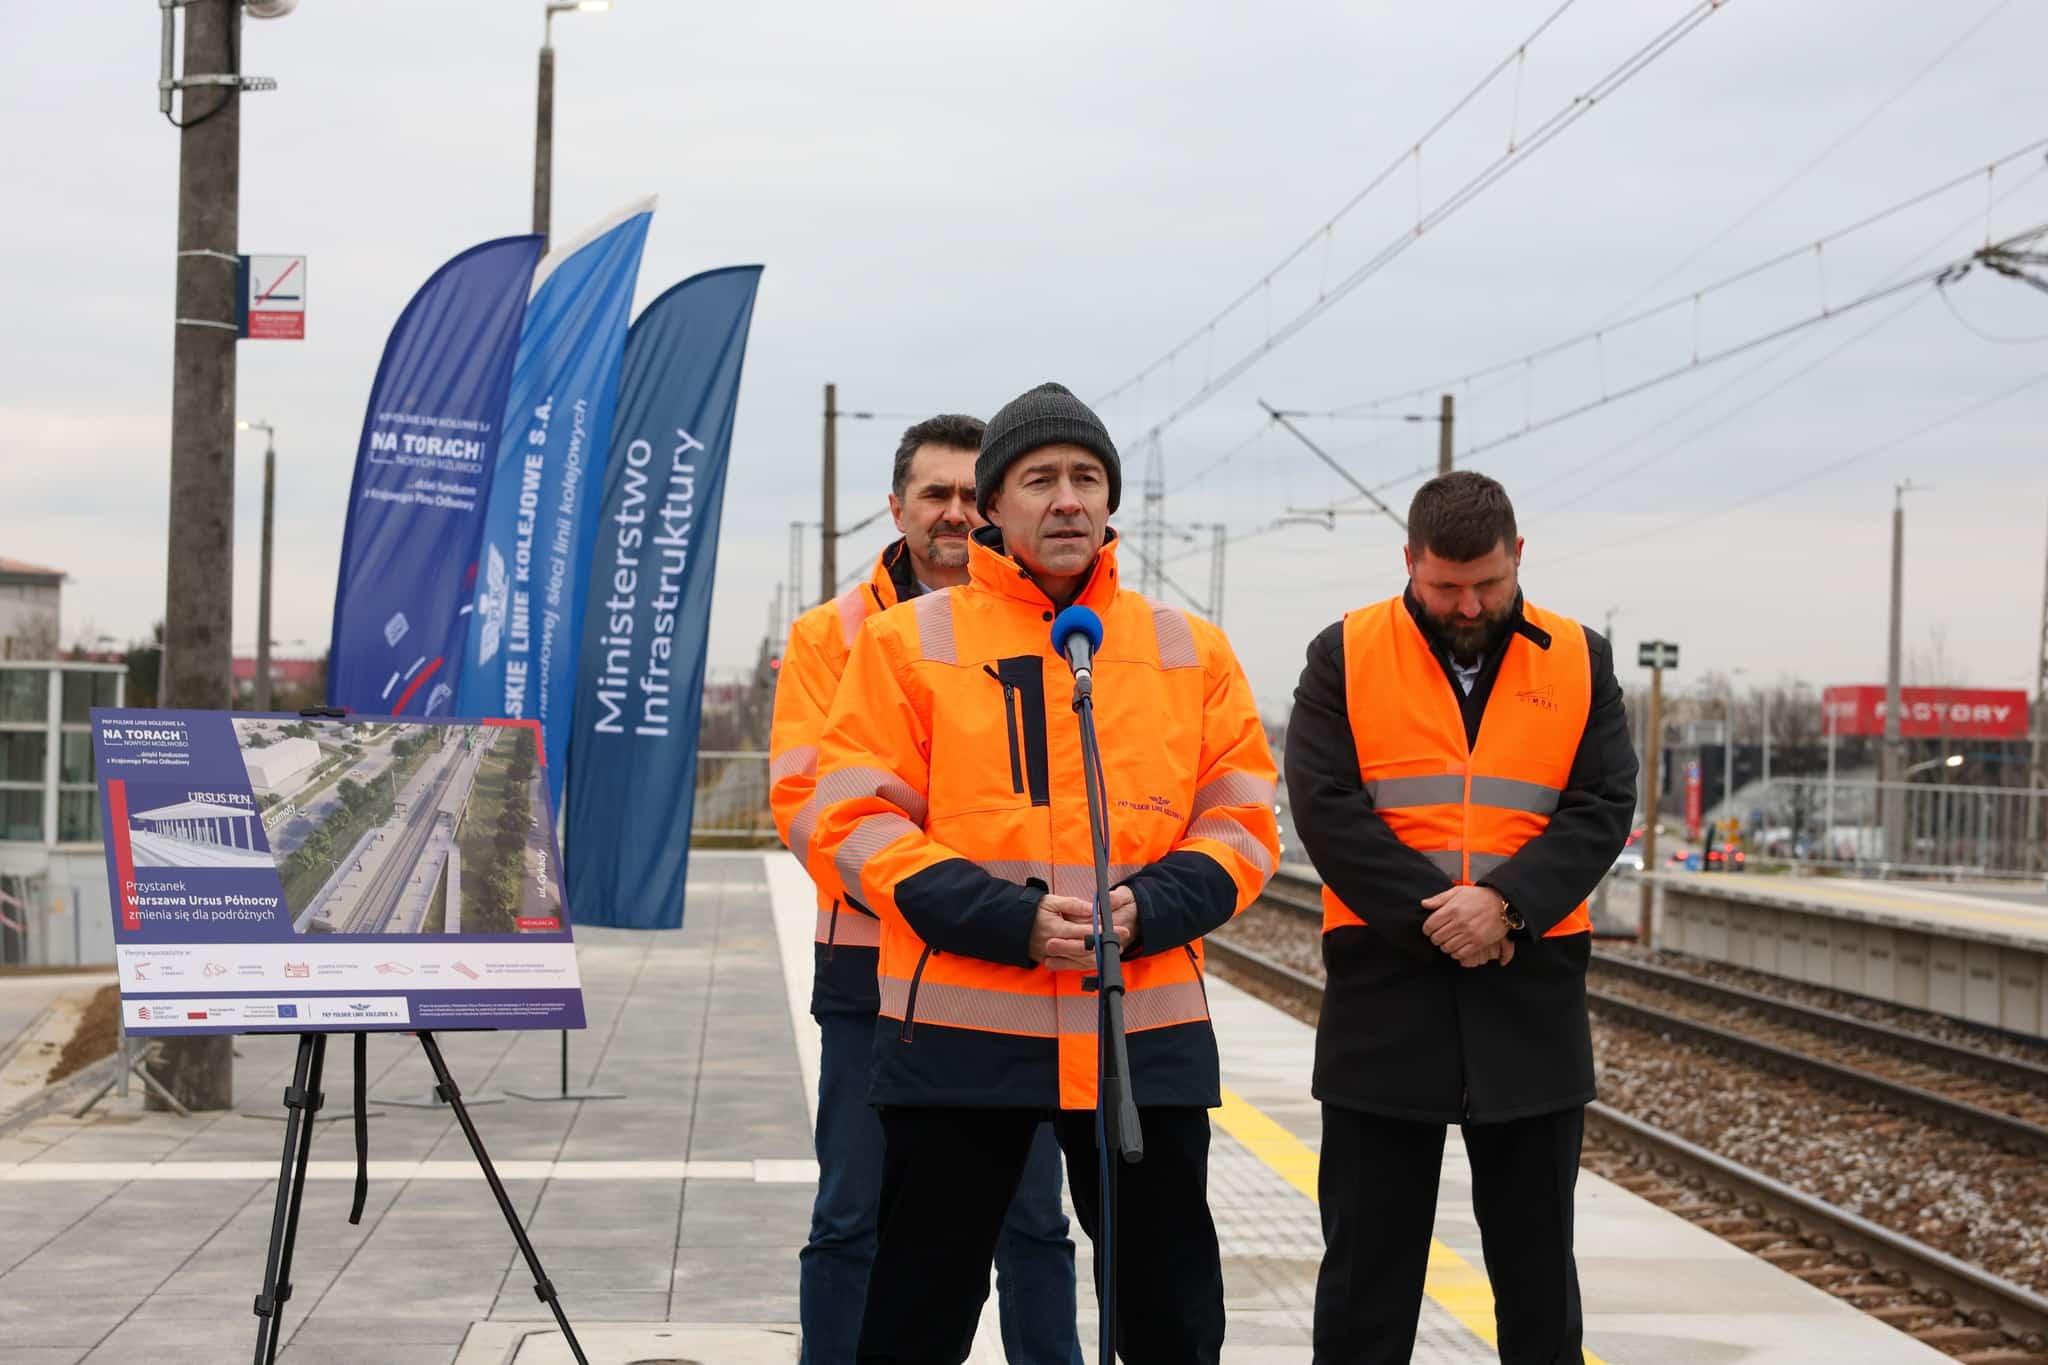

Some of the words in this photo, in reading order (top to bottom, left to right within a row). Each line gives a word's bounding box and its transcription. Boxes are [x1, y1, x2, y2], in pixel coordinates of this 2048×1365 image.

[371, 432, 397, 451] NA
[402, 434, 480, 460] TORACH
[529, 396, 553, 446] S.A.
[559, 399, 587, 515] kolejowych
[516, 454, 543, 582] KOLEJOWE
[552, 517, 573, 554] linii
[546, 555, 567, 607] sieci
[594, 438, 651, 734] Ministerstwo
[635, 428, 704, 736] Infrastruktury
[509, 591, 529, 652] LINIE
[505, 661, 528, 721] SKIE
[103, 728, 122, 740] NA
[125, 730, 180, 741] TORACH
[188, 792, 226, 803] URSUS
[126, 880, 186, 893] Przystanek
[127, 895, 186, 906] Warszawa
[189, 895, 222, 906] Ursus
[225, 895, 278, 908] Północny
[129, 909, 172, 920] zmienia
[174, 909, 190, 922] się
[192, 909, 209, 920] dla
[212, 909, 275, 922] podróżnych
